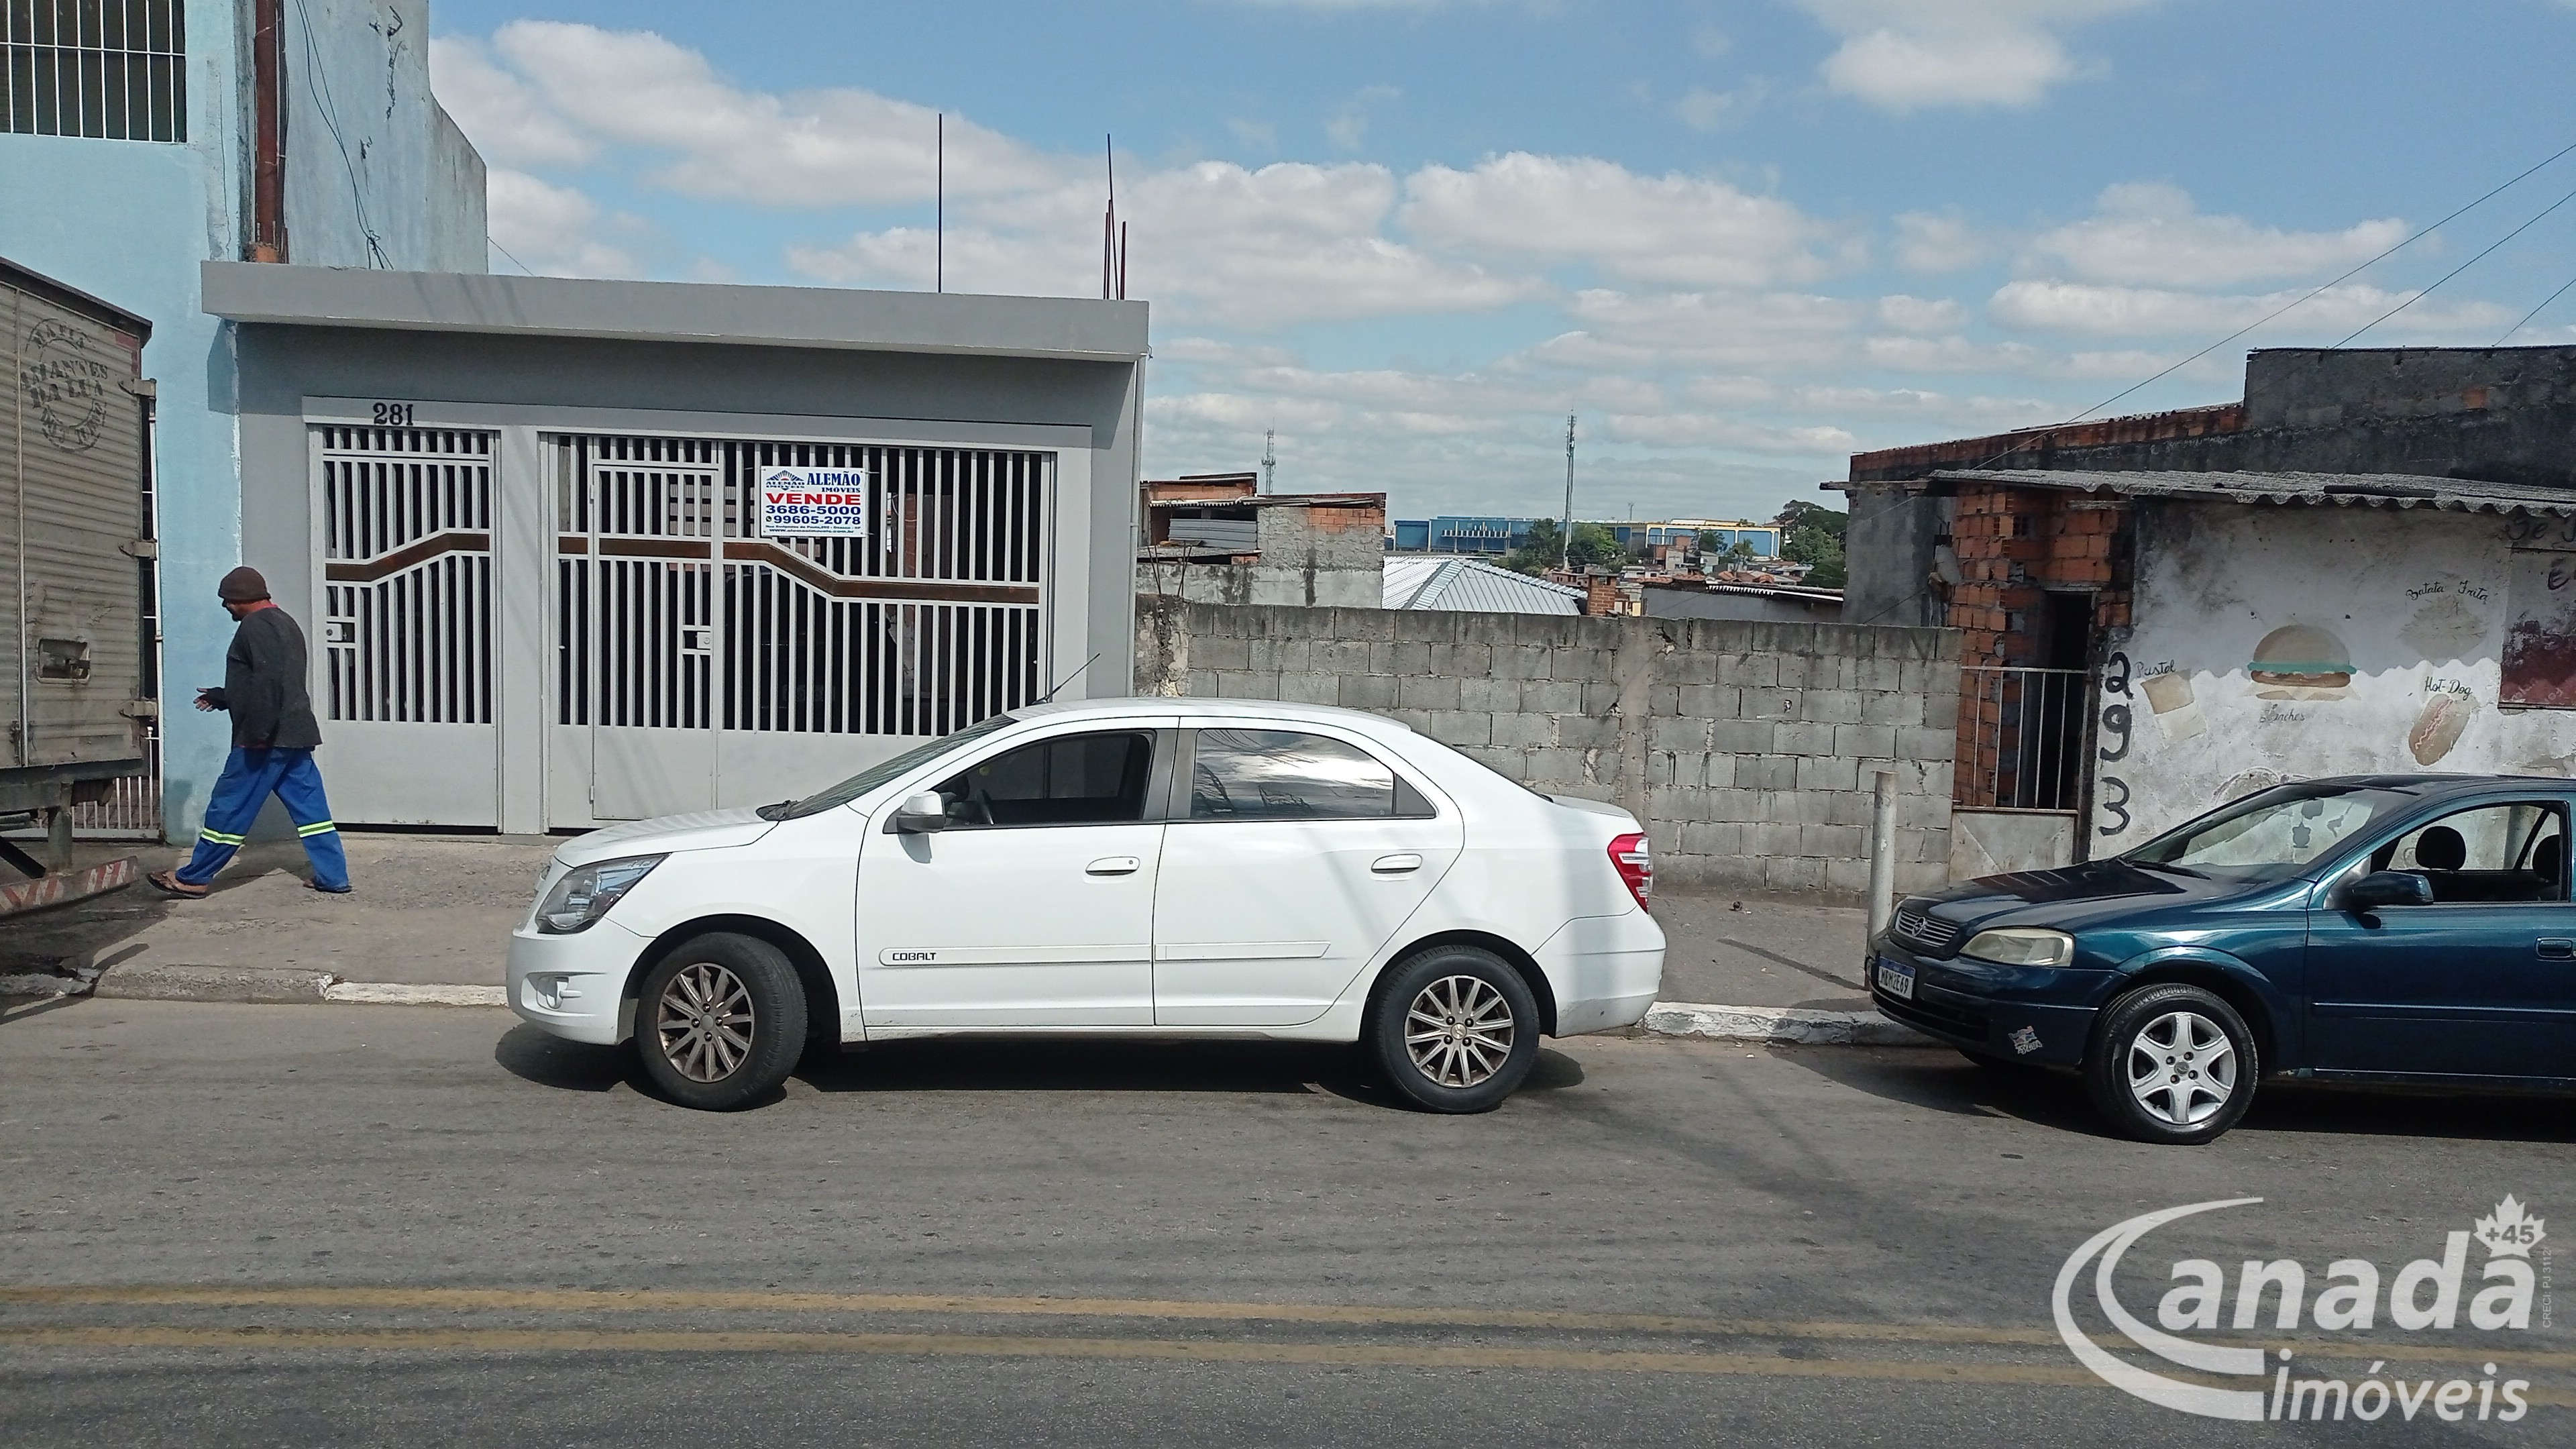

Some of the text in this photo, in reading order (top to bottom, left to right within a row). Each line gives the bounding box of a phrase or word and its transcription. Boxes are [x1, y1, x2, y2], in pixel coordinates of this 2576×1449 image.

[373, 402, 413, 425] 281
[807, 471, 861, 486] ALEMÃO
[765, 493, 861, 505] VENDE
[765, 505, 861, 515] 3686-5000
[773, 515, 861, 525] 99605-2078
[2405, 581, 2444, 601] Batata
[2424, 676, 2473, 700] Hot-Dog
[892, 953, 936, 961] COBALT
